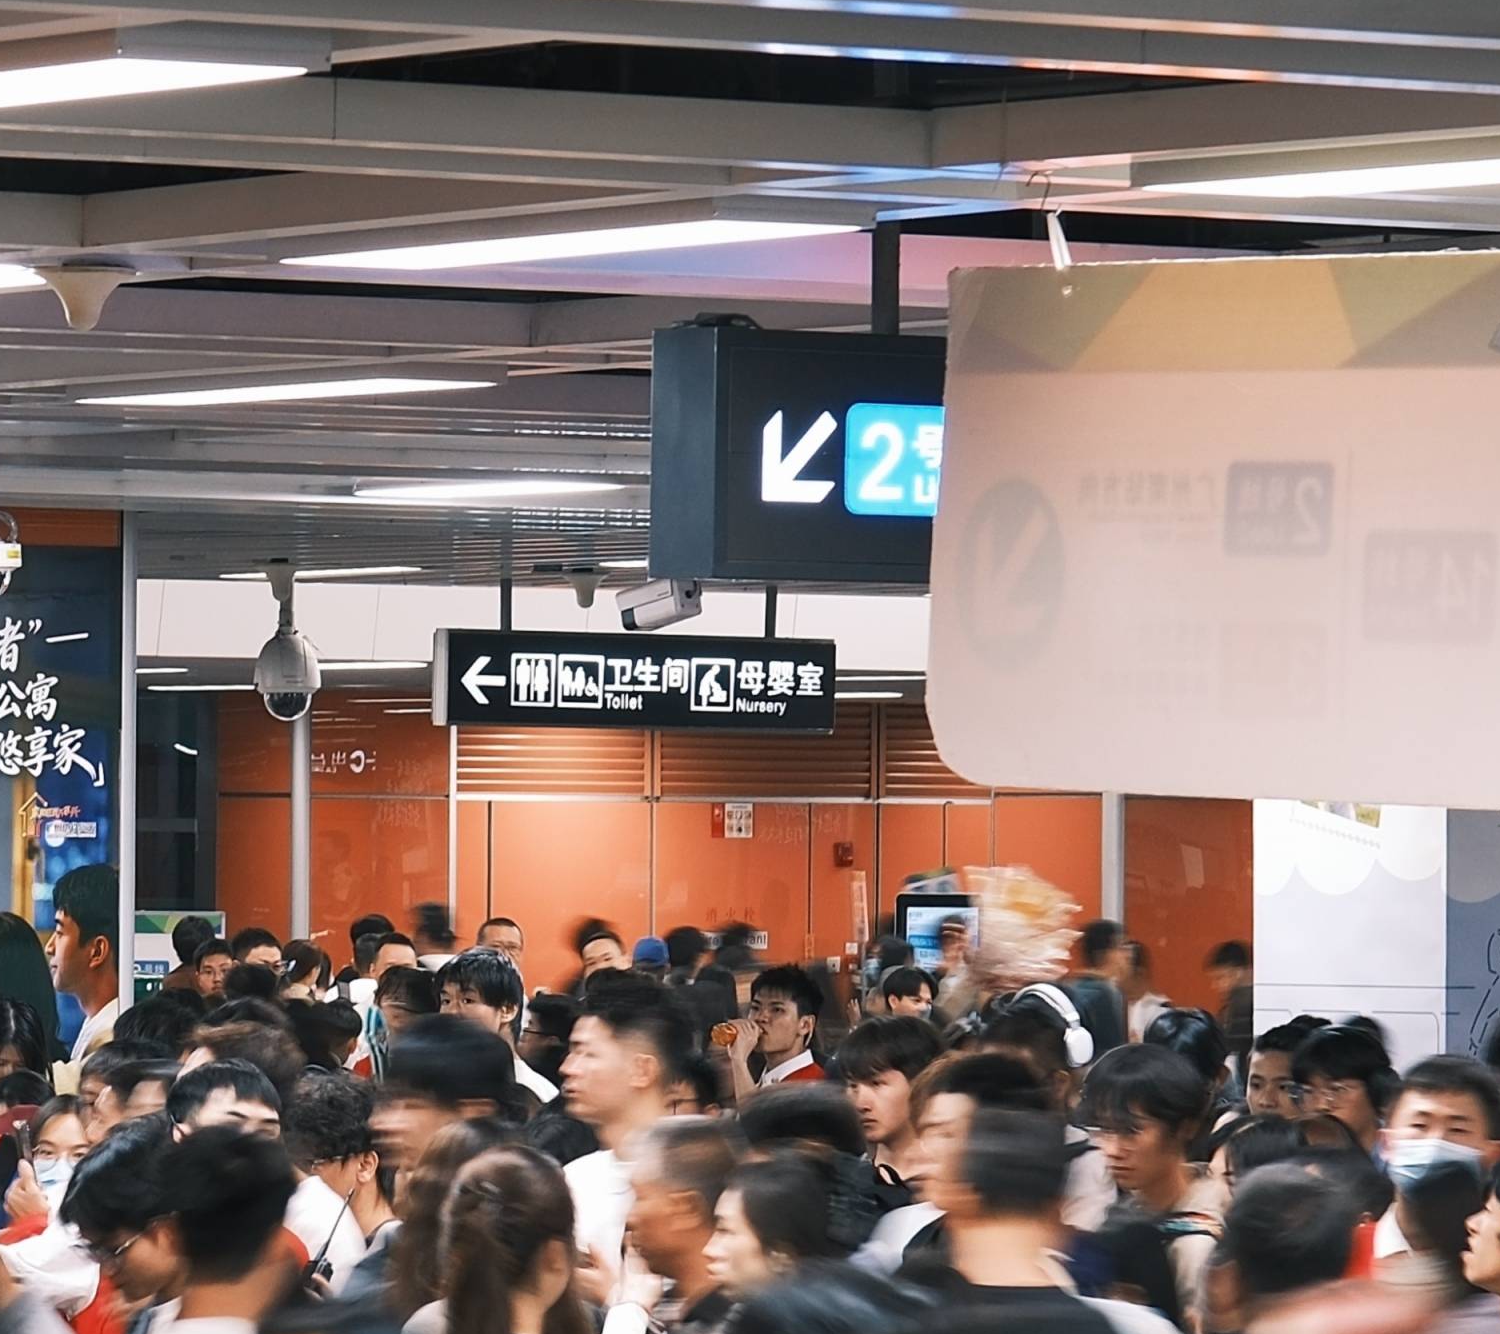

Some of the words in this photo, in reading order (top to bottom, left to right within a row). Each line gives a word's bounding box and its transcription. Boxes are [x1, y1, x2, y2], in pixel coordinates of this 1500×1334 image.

[604, 657, 690, 694] 卫生间
[736, 661, 825, 696] 母婴室
[604, 693, 643, 710] Toilet
[736, 698, 786, 716] Nursery
